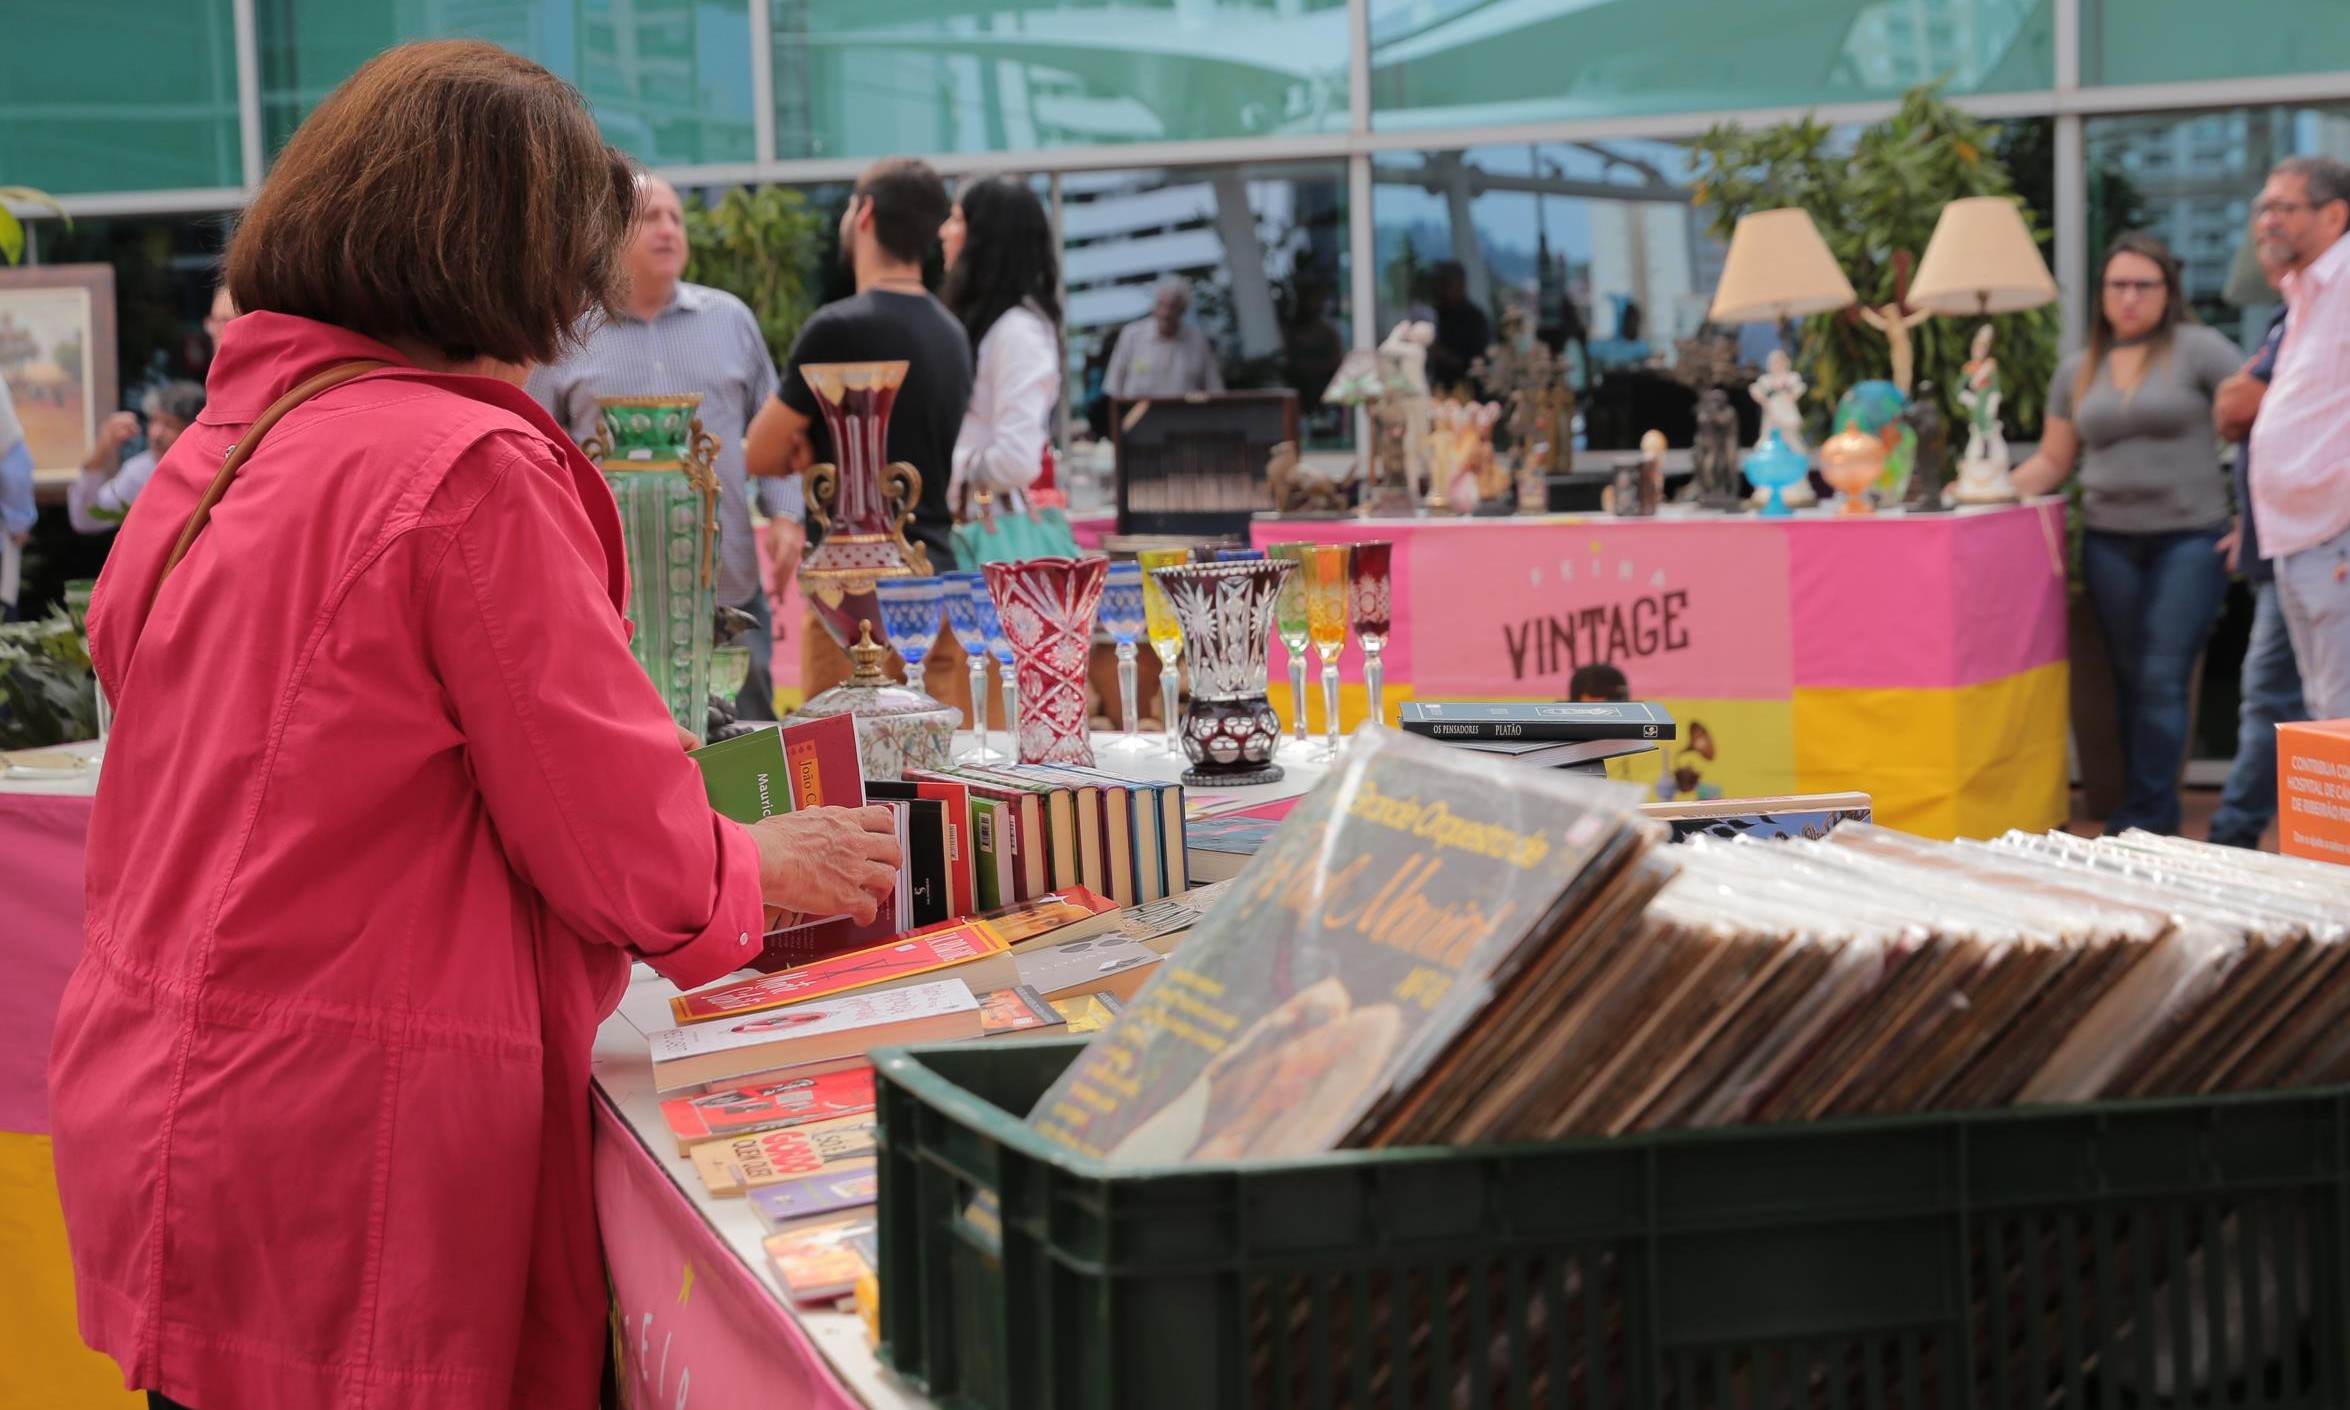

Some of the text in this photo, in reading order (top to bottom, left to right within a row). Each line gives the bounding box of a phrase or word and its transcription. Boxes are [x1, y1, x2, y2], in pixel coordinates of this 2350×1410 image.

[1529, 558, 1667, 588] FEIRA
[1503, 590, 1690, 680] VINTAGE
[1433, 723, 1522, 736] OS PENSADORES PLATÃO
[799, 760, 813, 790] João
[2287, 775, 2323, 797] HOSPITAL
[733, 1139, 762, 1161] QUEM
